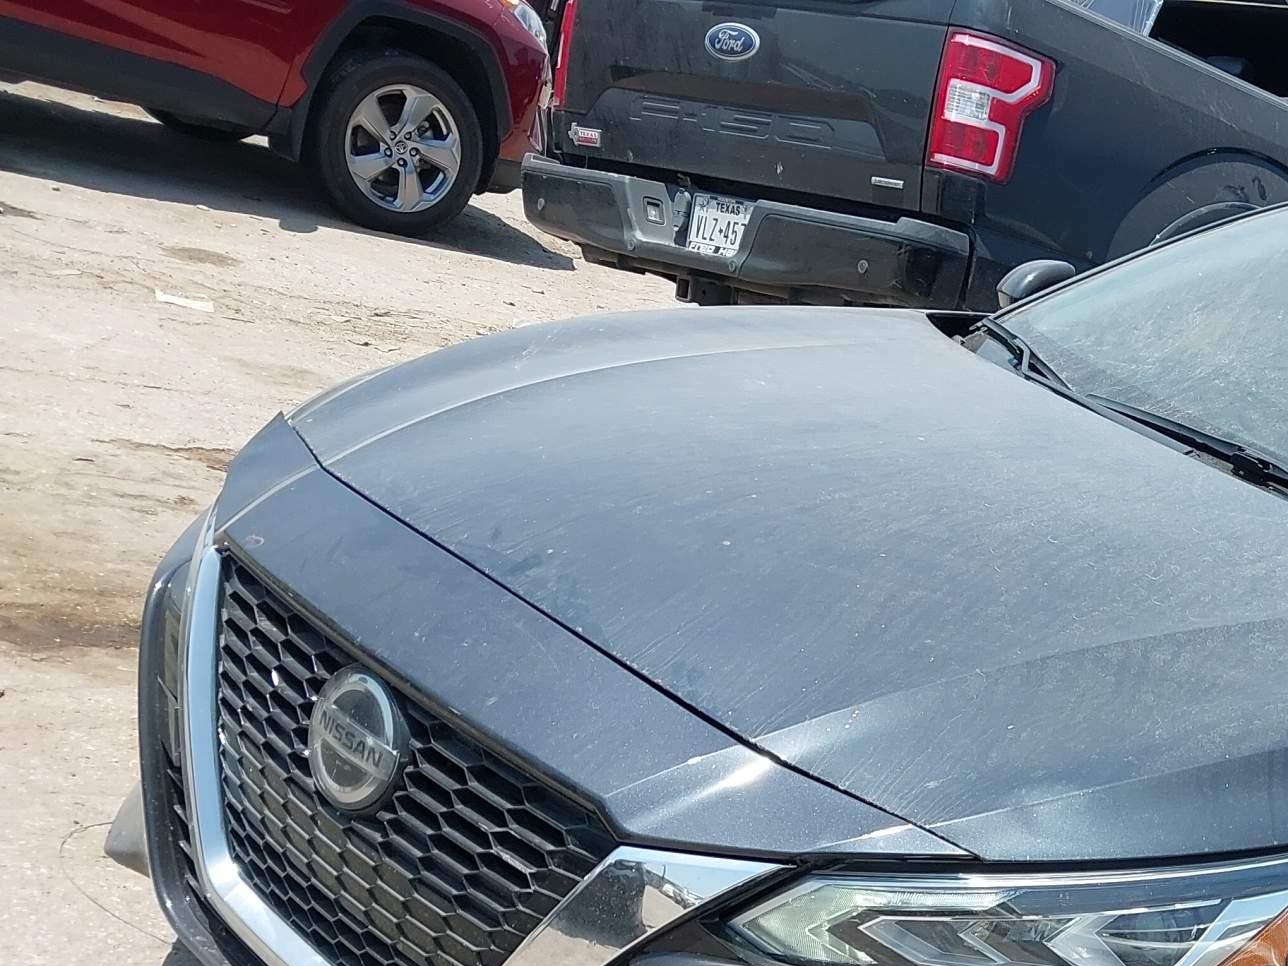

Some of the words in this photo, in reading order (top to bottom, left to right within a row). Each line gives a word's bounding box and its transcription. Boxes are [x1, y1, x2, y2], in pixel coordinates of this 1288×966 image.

[715, 29, 746, 52] Ford
[716, 202, 741, 216] TEXAS
[319, 710, 384, 769] NISSAN
